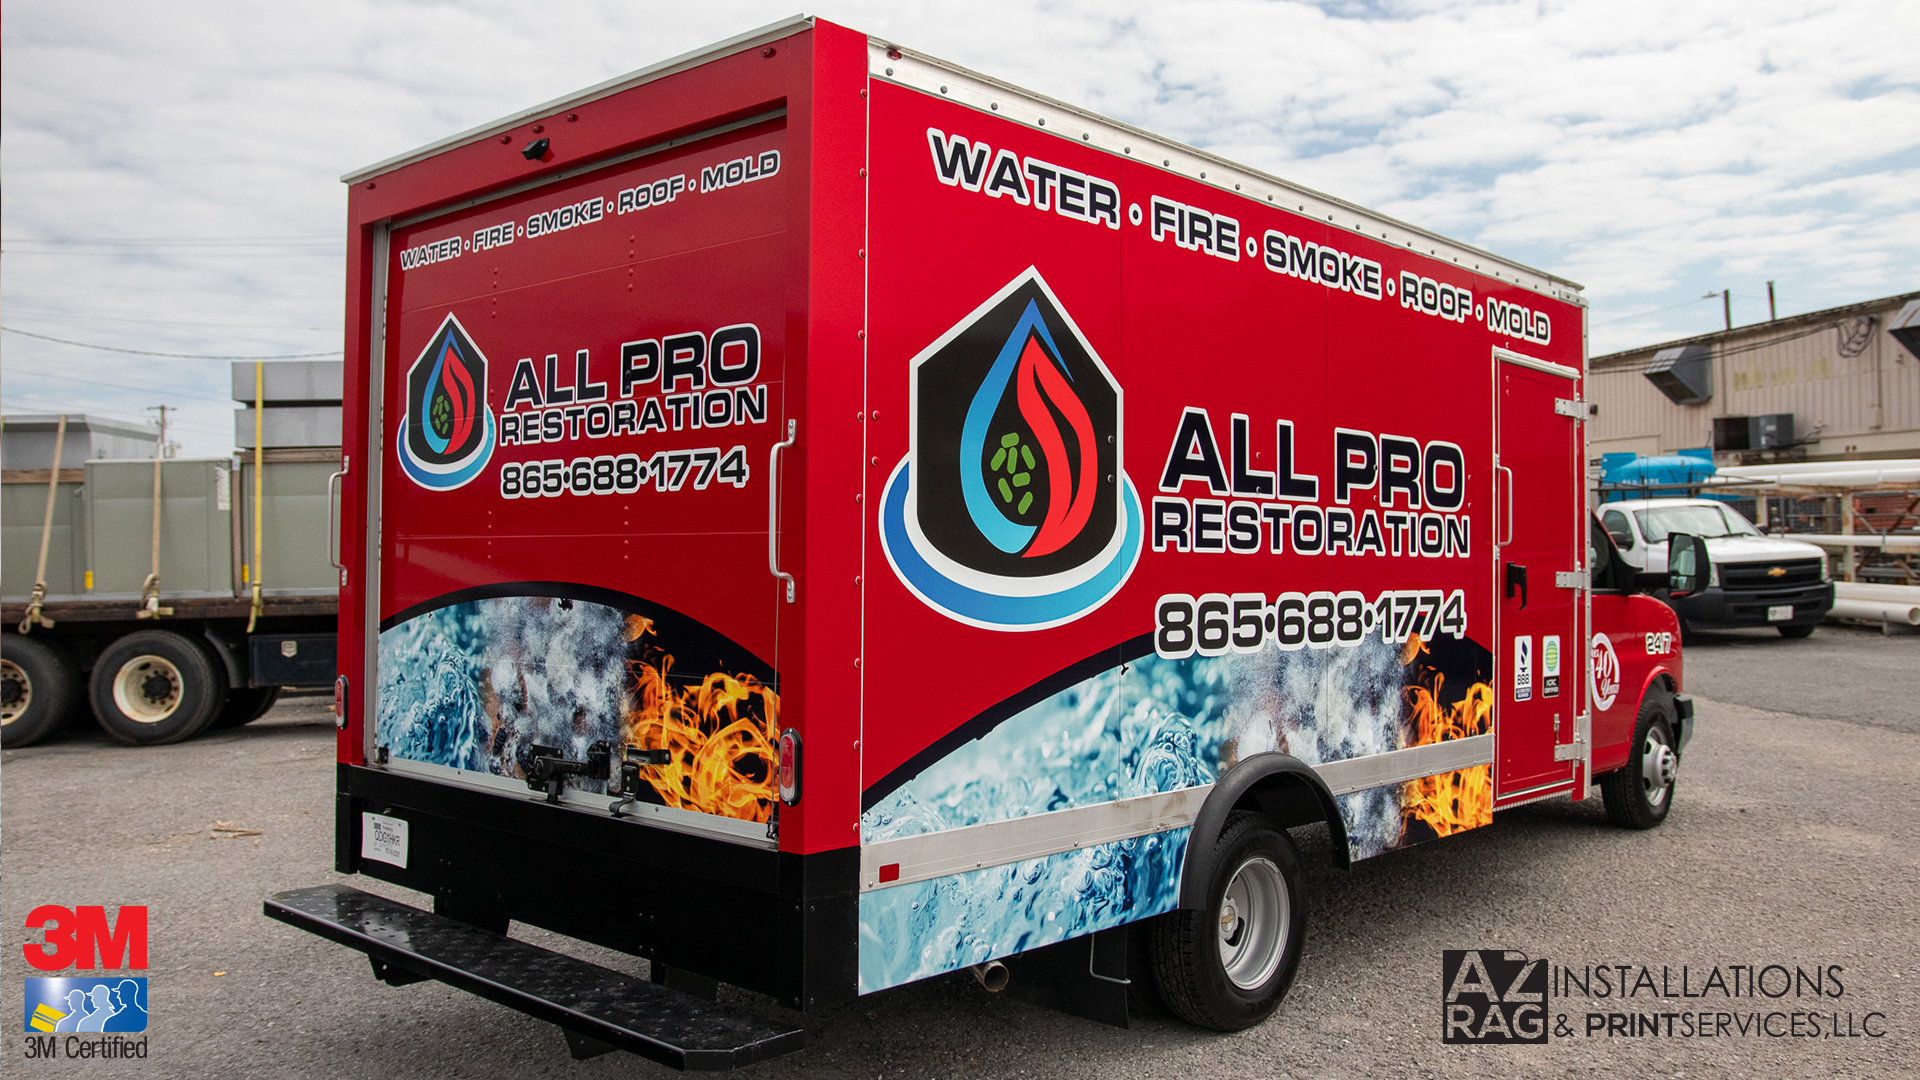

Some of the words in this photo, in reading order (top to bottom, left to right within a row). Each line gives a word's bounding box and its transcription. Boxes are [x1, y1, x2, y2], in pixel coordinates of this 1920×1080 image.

[400, 237, 462, 270] WATER
[472, 222, 514, 252] FIRE
[527, 197, 603, 239] SMOKE
[617, 175, 685, 215] ROOF
[700, 150, 780, 194] MOLD
[927, 127, 1121, 230] WATER
[1151, 194, 1240, 262] FIRE
[1264, 229, 1382, 301] SMOKE
[1400, 270, 1473, 323] ROOF
[1487, 296, 1551, 345] MOLD
[504, 349, 607, 413] ALL
[620, 322, 761, 397] PRO
[500, 385, 767, 446] RESTORATION
[1159, 406, 1319, 502] ALL
[1334, 427, 1465, 512] PRO
[1152, 496, 1470, 558] RESTORATION
[1518, 674, 1529, 685] BBB
